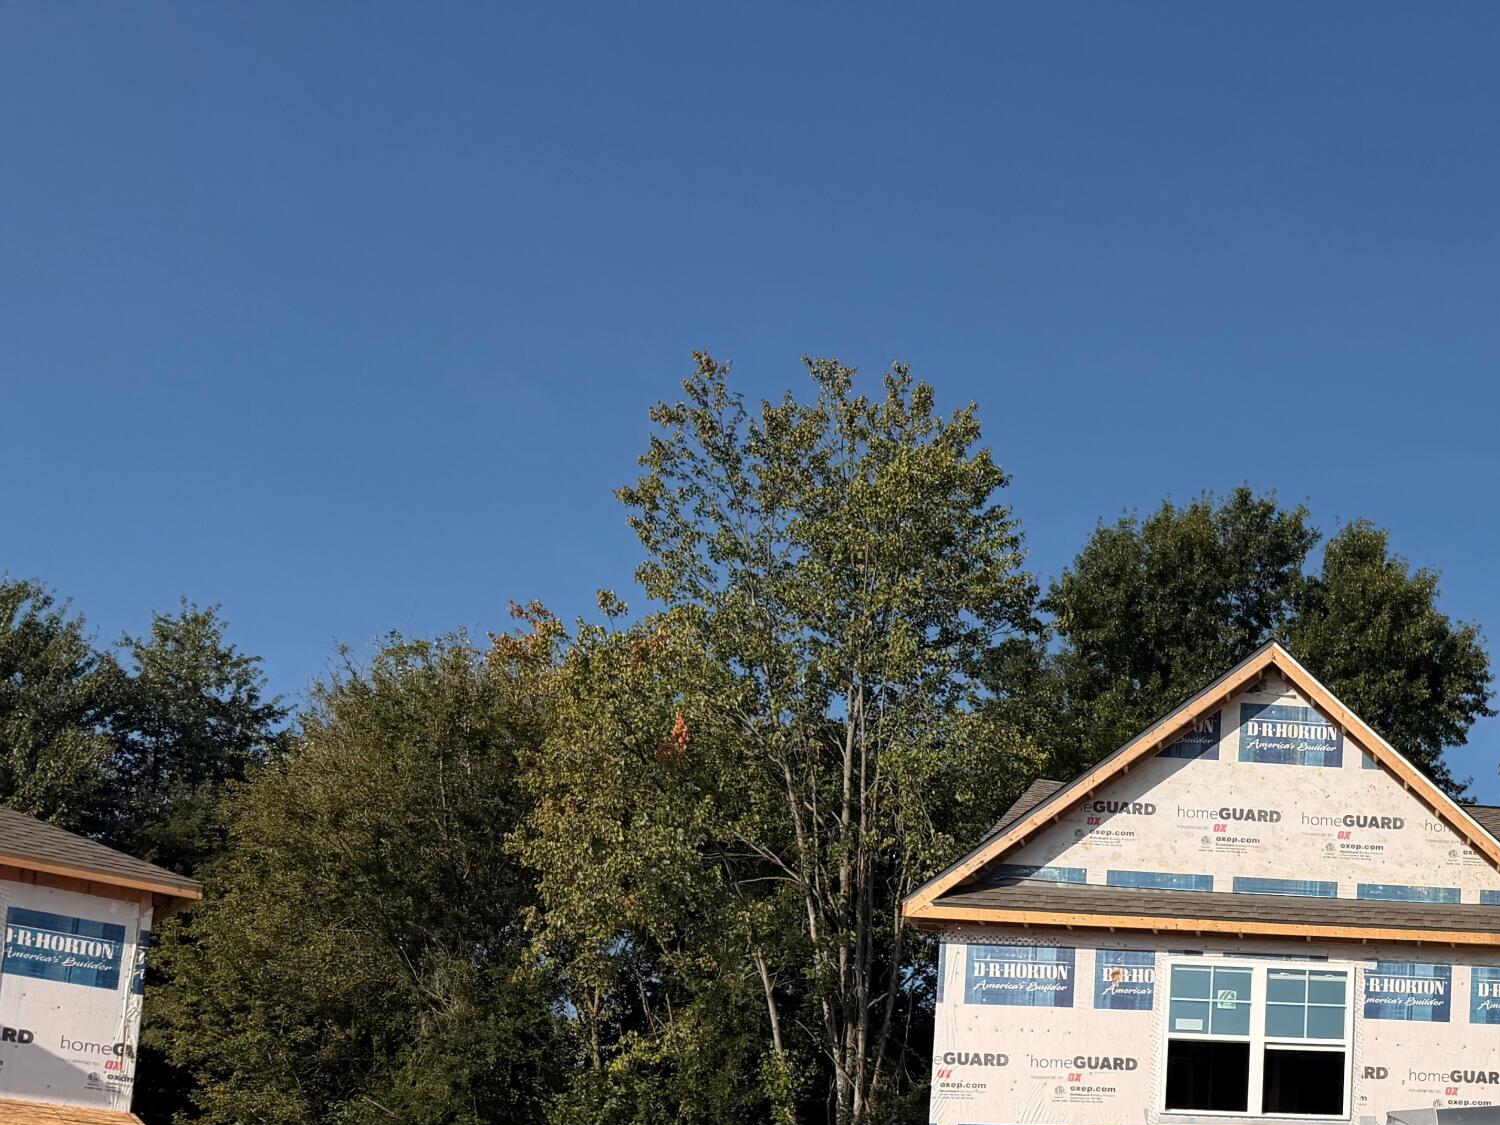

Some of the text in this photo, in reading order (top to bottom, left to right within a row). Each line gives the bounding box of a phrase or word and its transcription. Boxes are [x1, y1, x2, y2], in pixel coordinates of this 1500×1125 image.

[1297, 741, 1337, 752] Builder
[1080, 801, 1158, 816] eGUARD
[1177, 804, 1282, 823] homeGUARD
[1301, 812, 1405, 830] homeGUARD
[1212, 823, 1227, 833] OX
[1215, 836, 1261, 846] oxep.com
[1337, 831, 1352, 841] OX
[1340, 843, 1384, 852] oxep.com
[61, 957, 113, 972] Builder
[973, 979, 1024, 991] America's
[1406, 996, 1444, 1007] Builder
[933, 1051, 1010, 1067] eGUARD
[1030, 1055, 1138, 1071] homeGUARD
[1067, 1073, 1082, 1082] OX
[939, 1081, 987, 1091] oxep.com
[1070, 1085, 1116, 1094] oxep.com
[1445, 1087, 1460, 1096] OX
[1447, 1098, 1492, 1107] oxep.com
